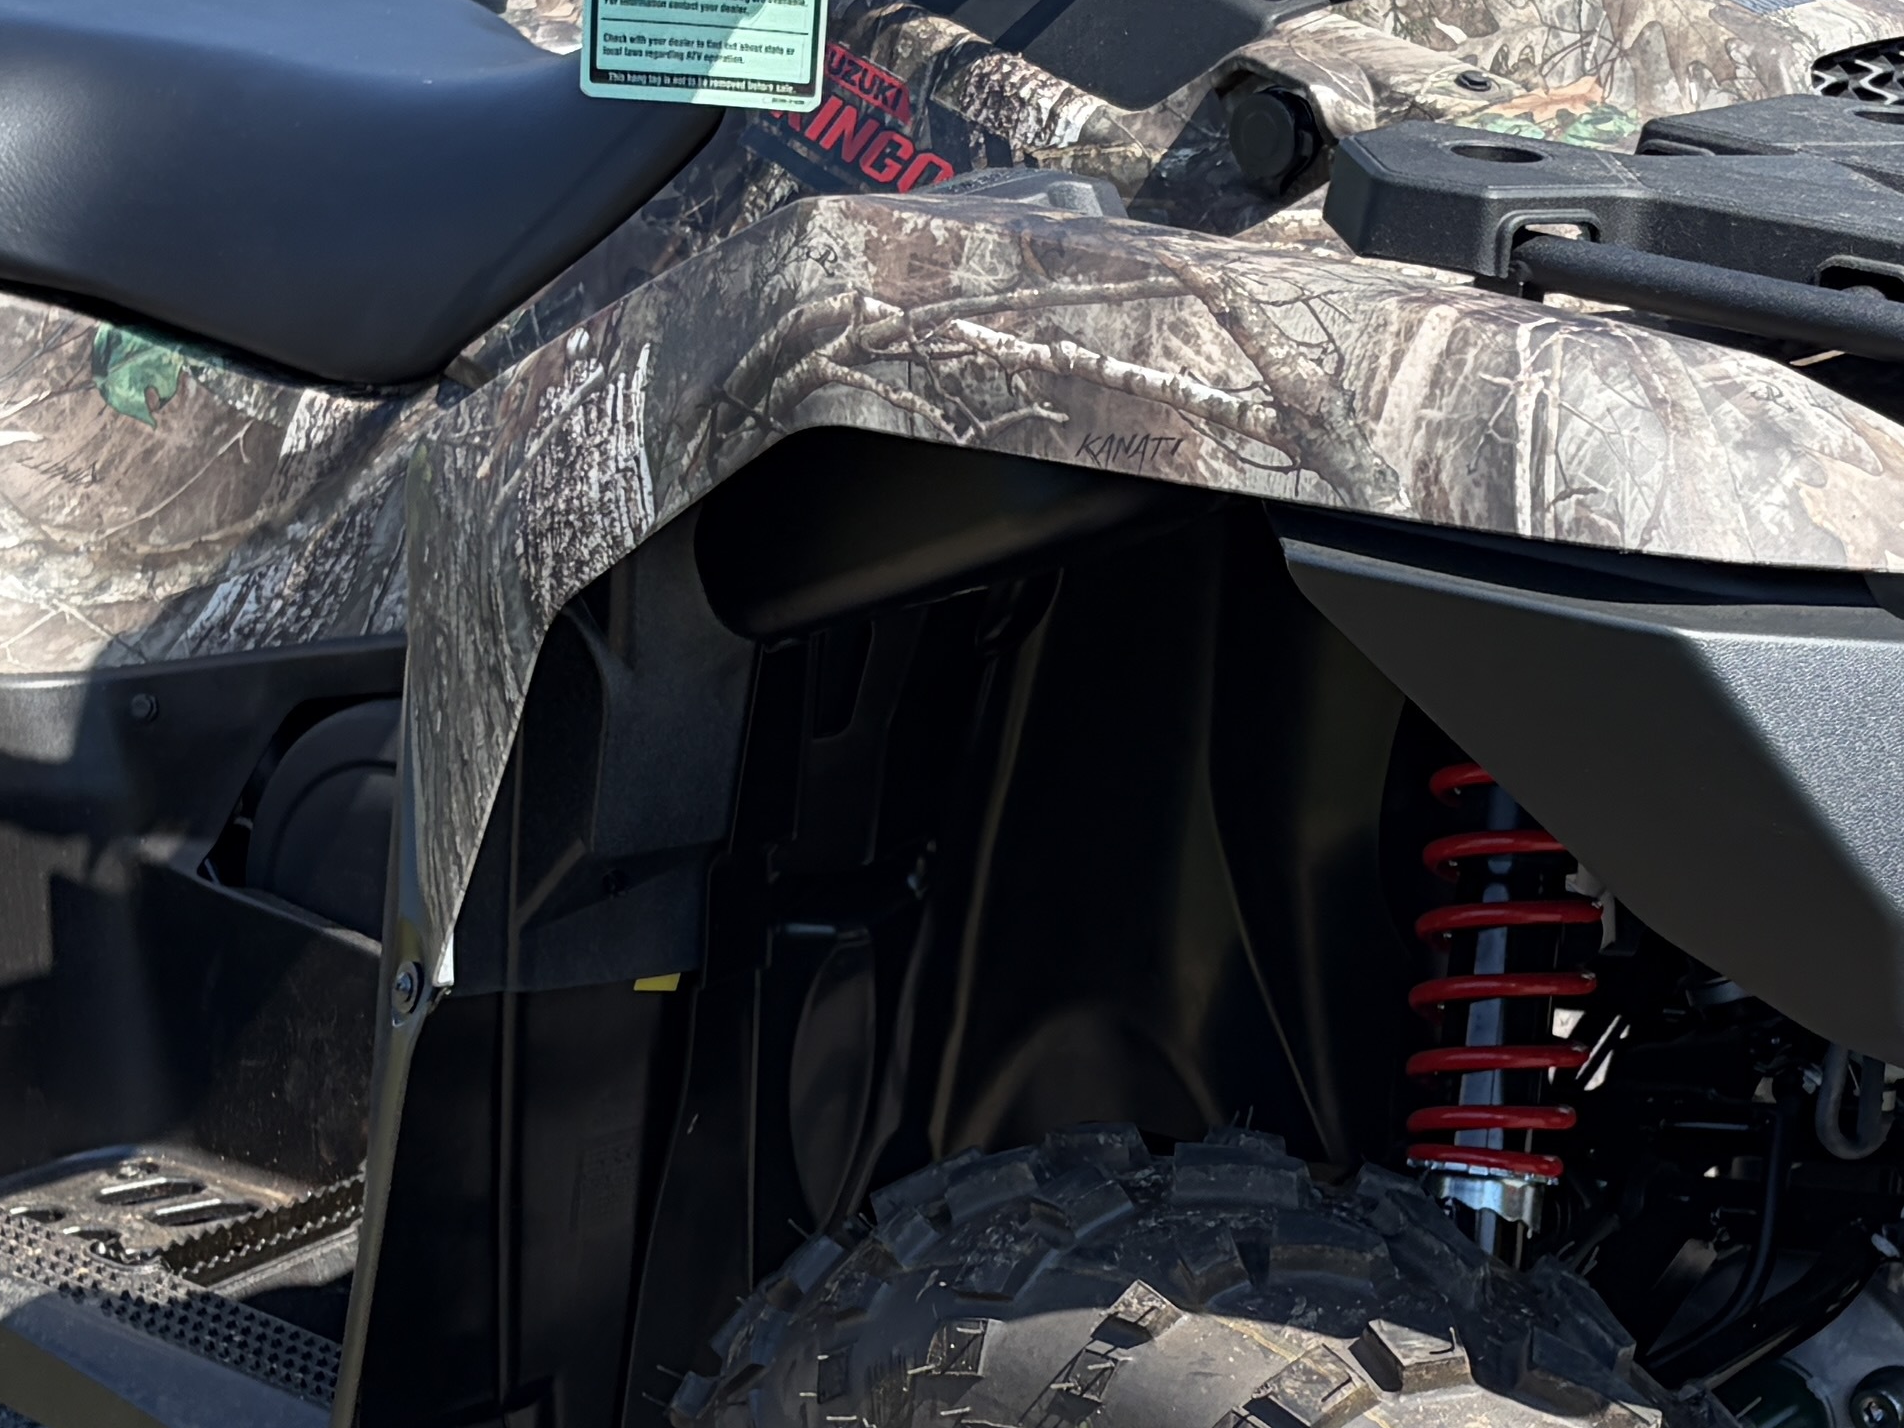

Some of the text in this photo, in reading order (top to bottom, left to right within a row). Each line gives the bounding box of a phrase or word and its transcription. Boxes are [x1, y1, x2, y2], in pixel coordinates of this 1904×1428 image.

[604, 33, 626, 44] Check
[827, 50, 903, 109] UZUKI
[1076, 433, 1184, 469] KANATI
